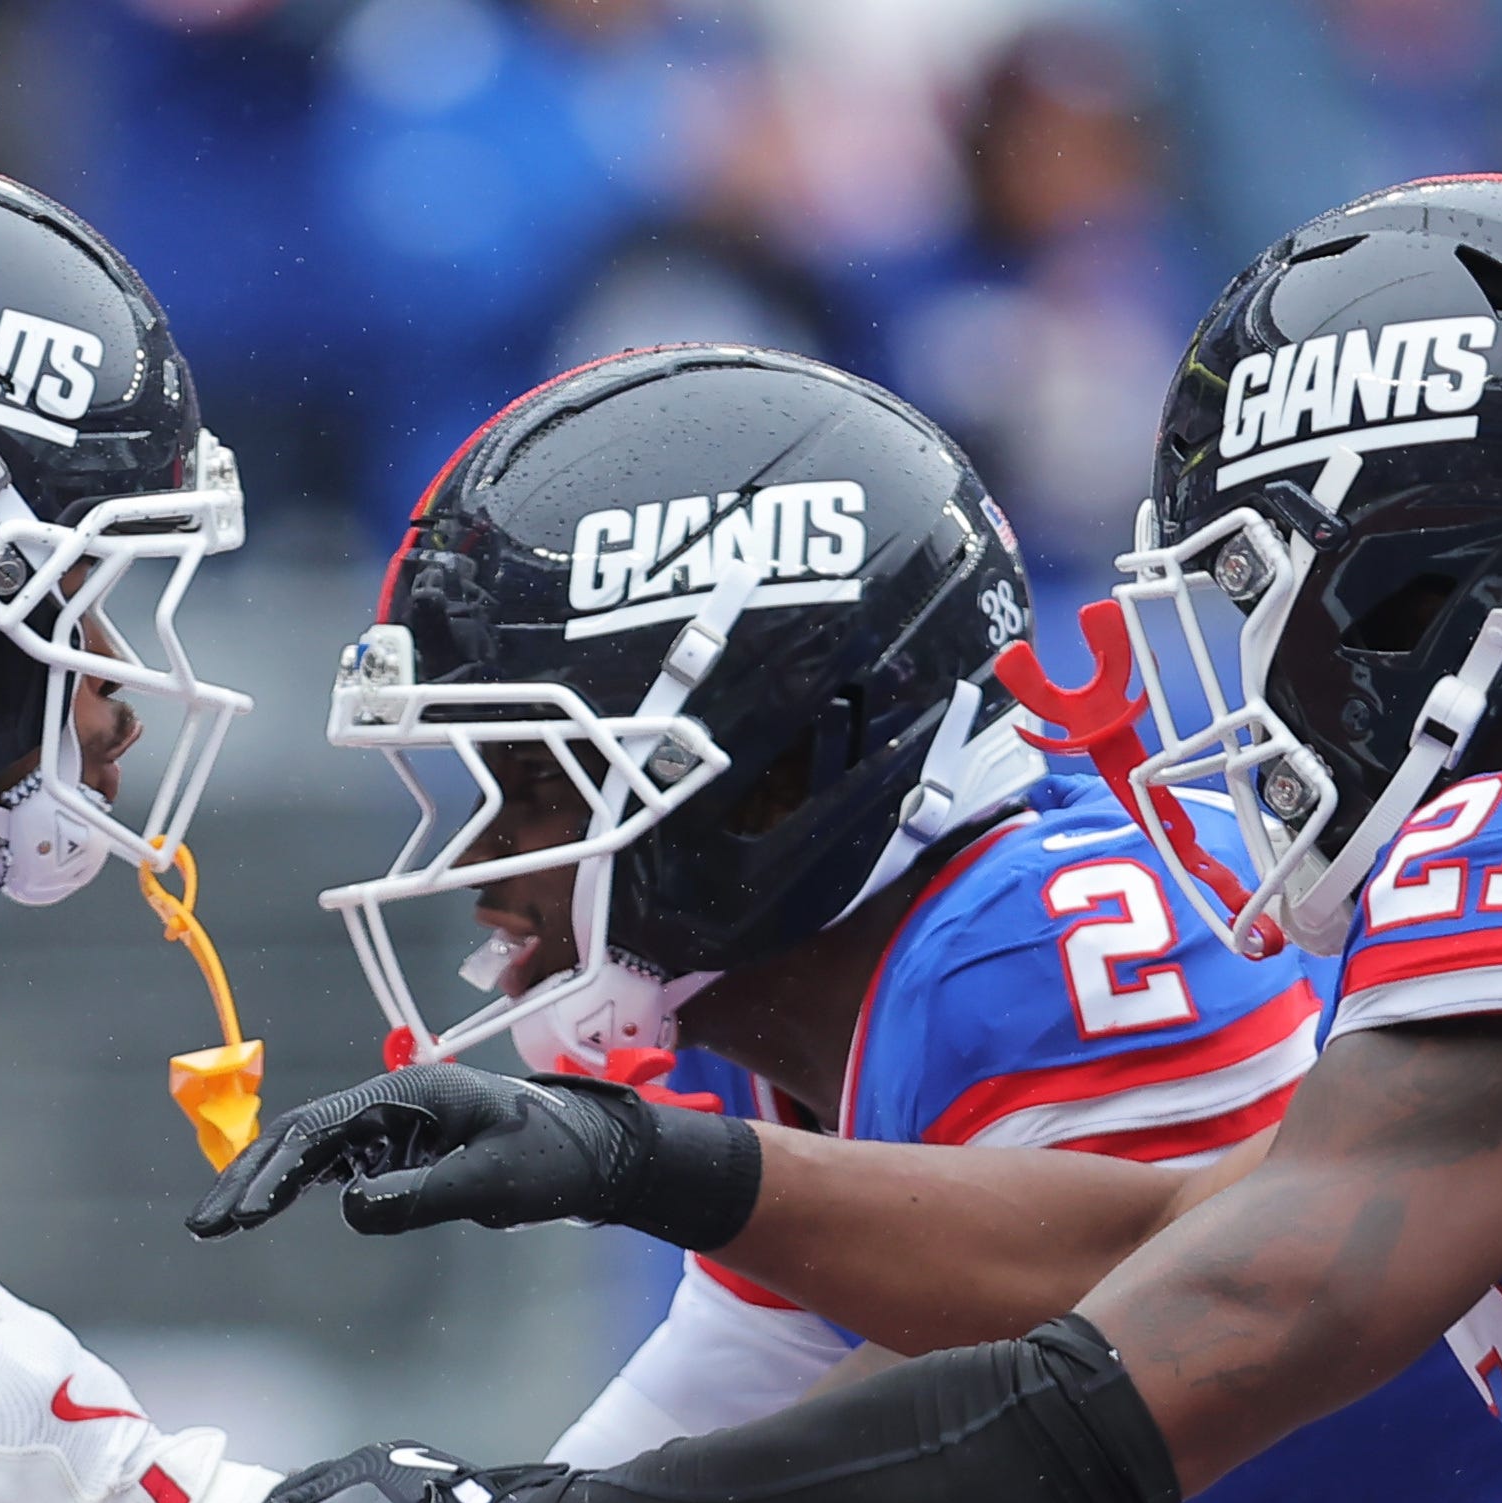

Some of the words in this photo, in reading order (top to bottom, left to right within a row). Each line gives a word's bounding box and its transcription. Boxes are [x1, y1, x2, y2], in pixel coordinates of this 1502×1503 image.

[1219, 316, 1497, 458] GIANTS
[569, 480, 866, 611] GIANTS
[981, 579, 1023, 646] 38
[1040, 857, 1200, 1042] 2
